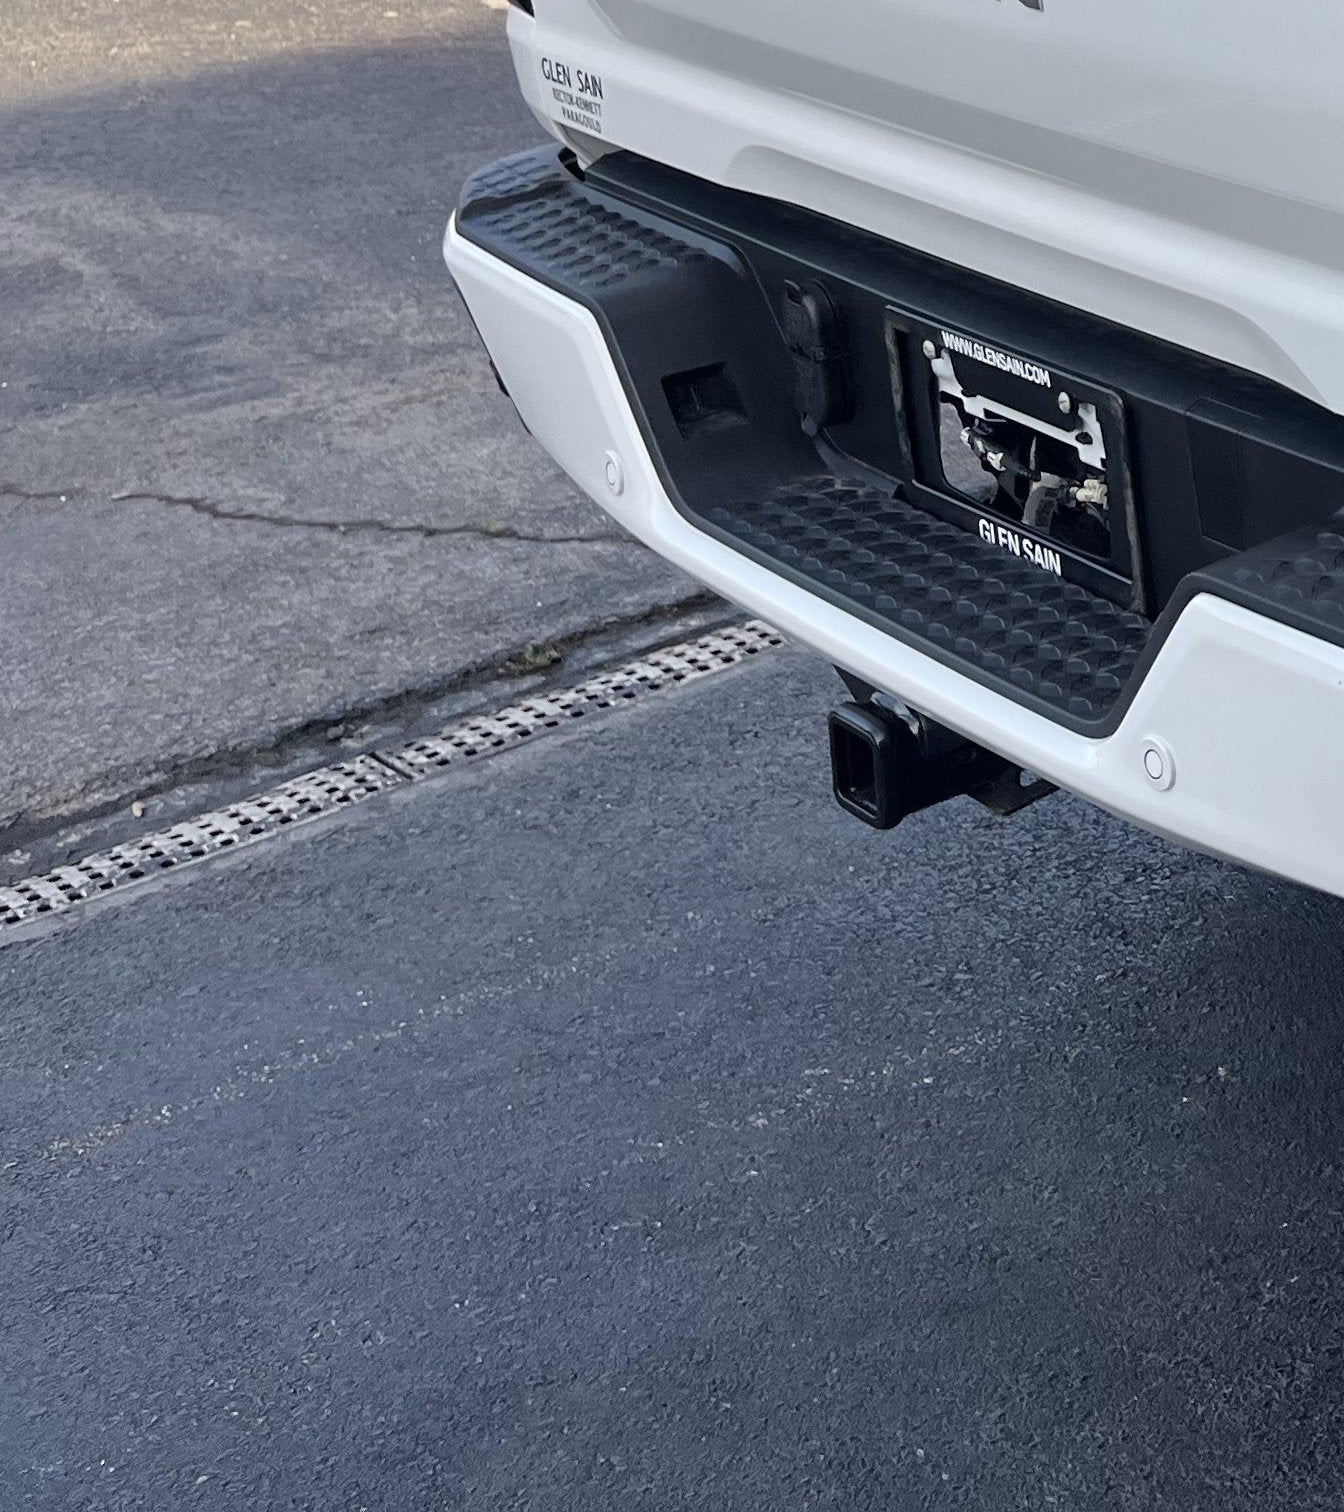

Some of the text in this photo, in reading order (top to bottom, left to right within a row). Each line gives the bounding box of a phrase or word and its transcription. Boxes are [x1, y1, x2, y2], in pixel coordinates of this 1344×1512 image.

[541, 57, 572, 89] GLEN
[940, 330, 1051, 388] WWW.GLENSAIN.COM
[1021, 538, 1062, 577] SAIN
